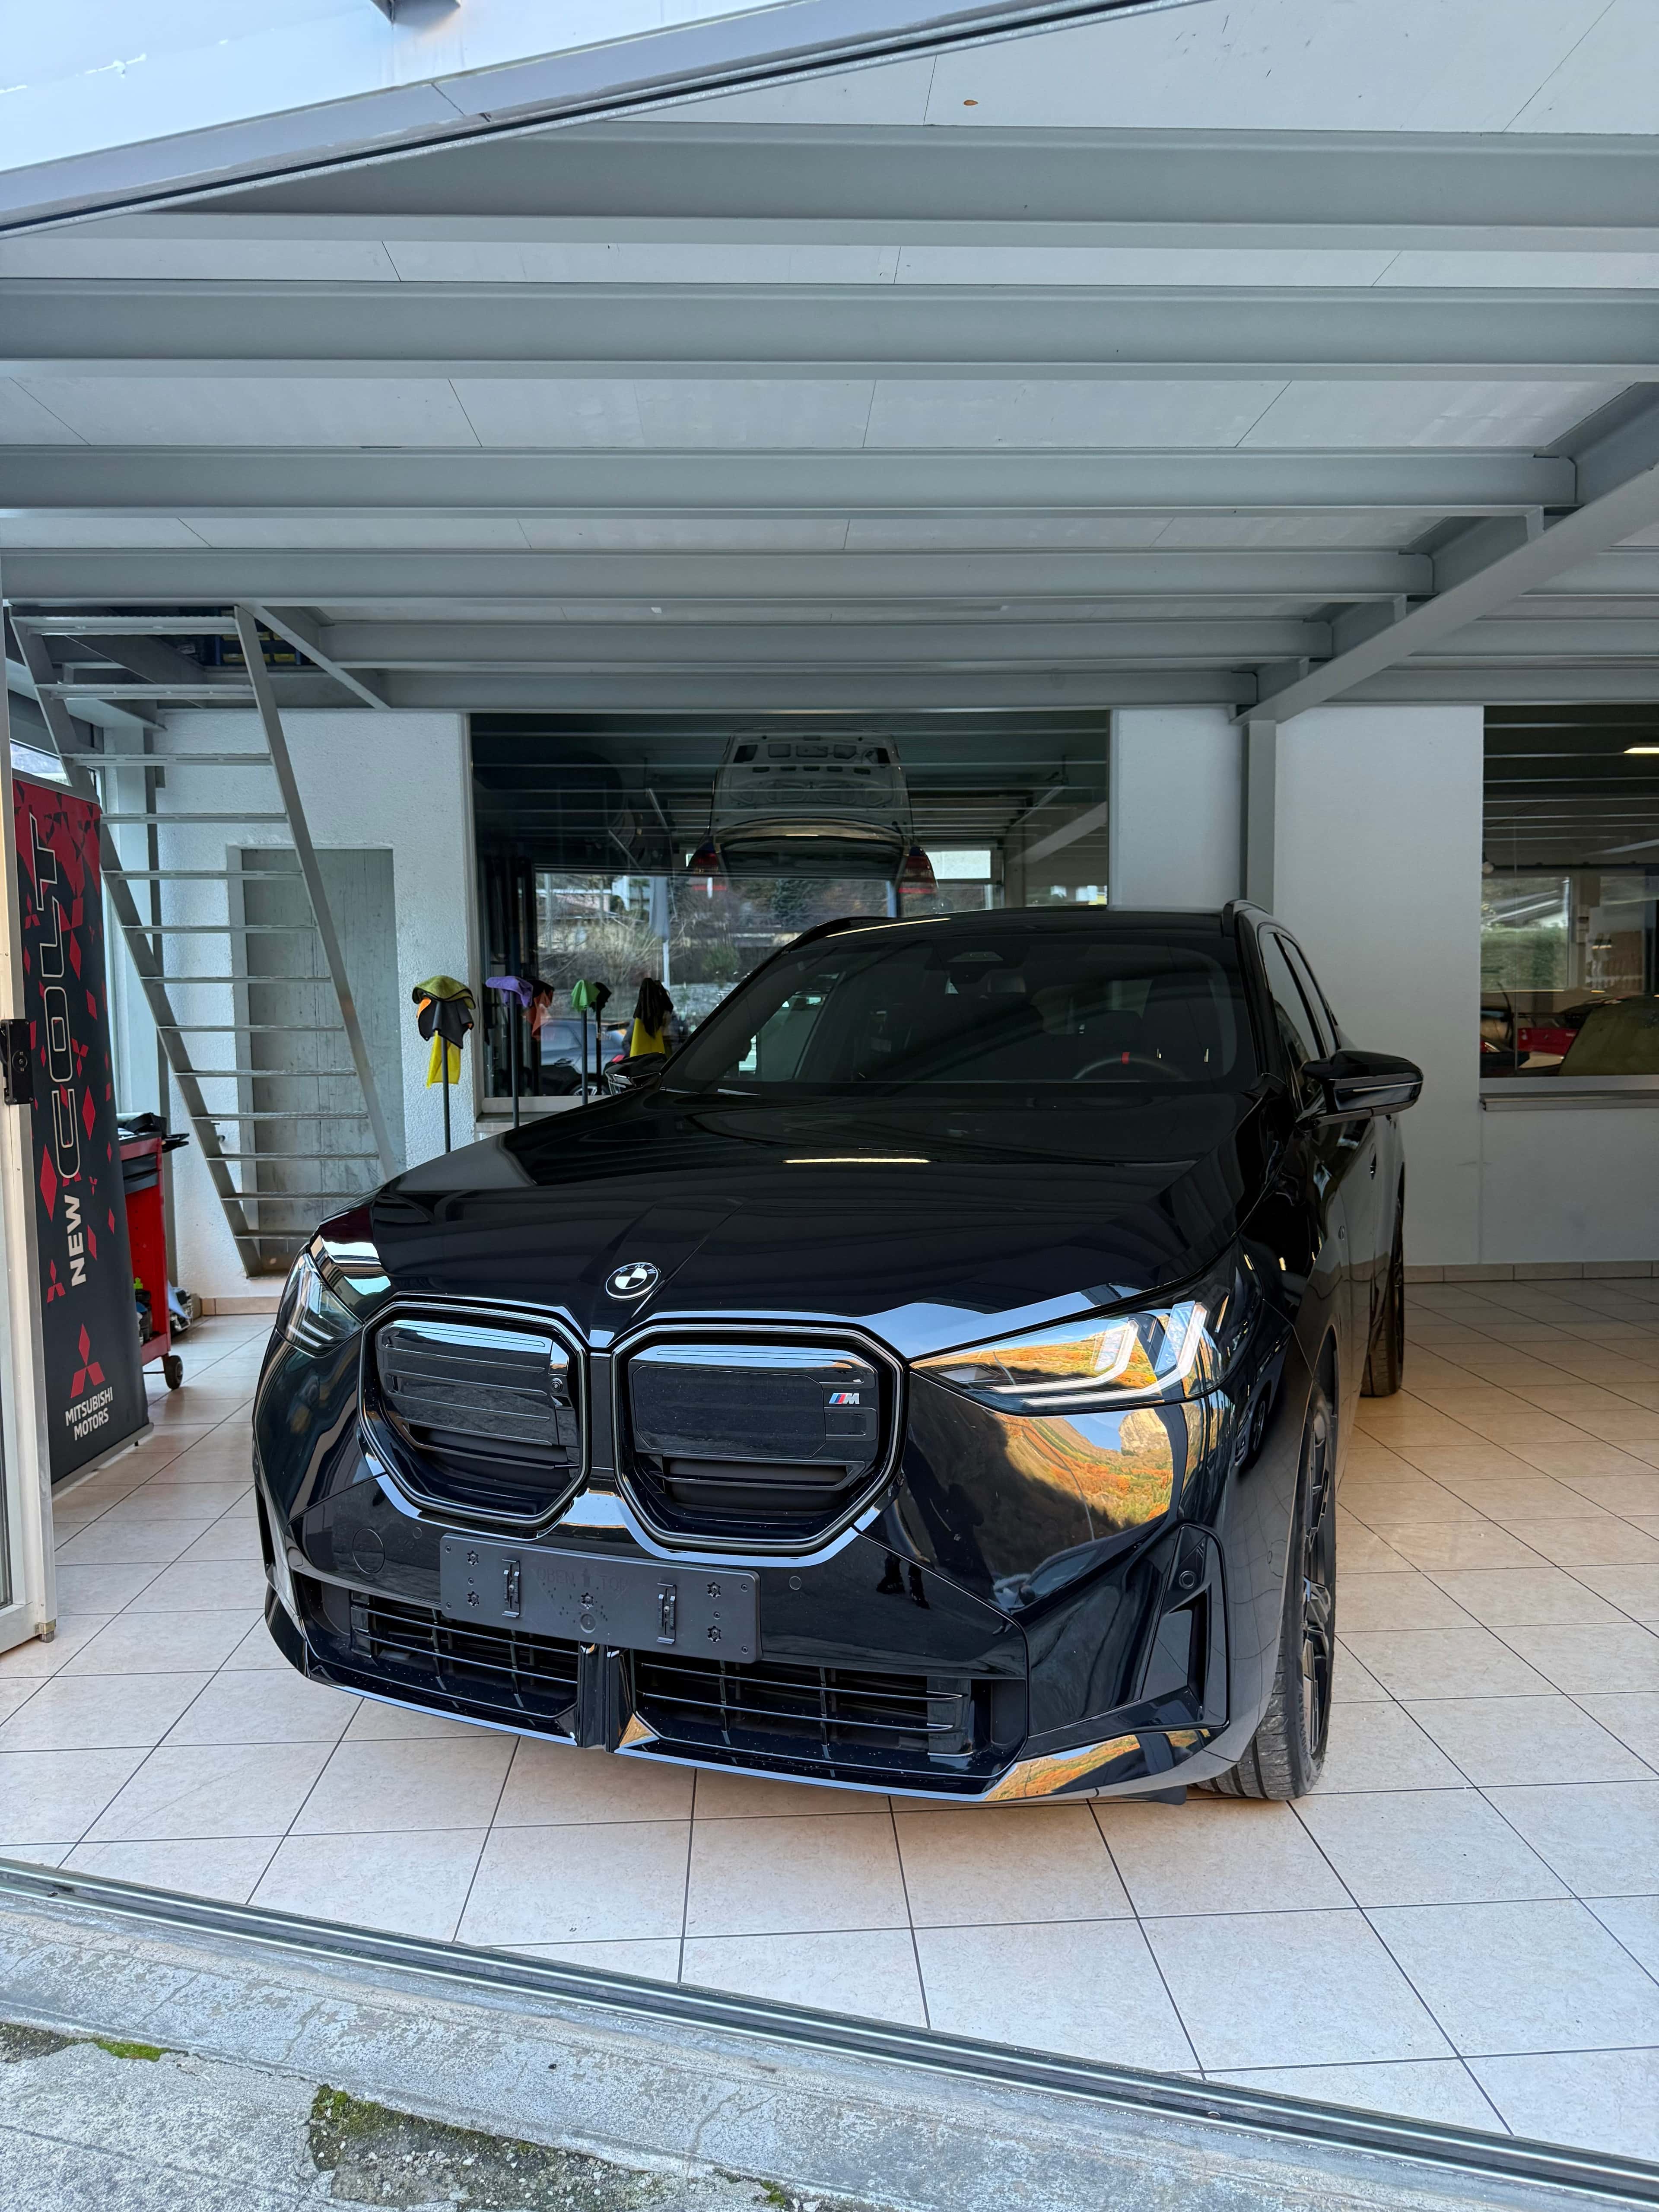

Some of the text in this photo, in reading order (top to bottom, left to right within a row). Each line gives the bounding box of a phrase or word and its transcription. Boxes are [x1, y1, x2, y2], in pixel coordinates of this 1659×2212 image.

[30, 812, 86, 1287] NEW COLT
[65, 1386, 113, 1426] MITSUBISHI
[73, 1407, 109, 1441] MOTORS
[537, 1567, 628, 1591] OBEN TOP
